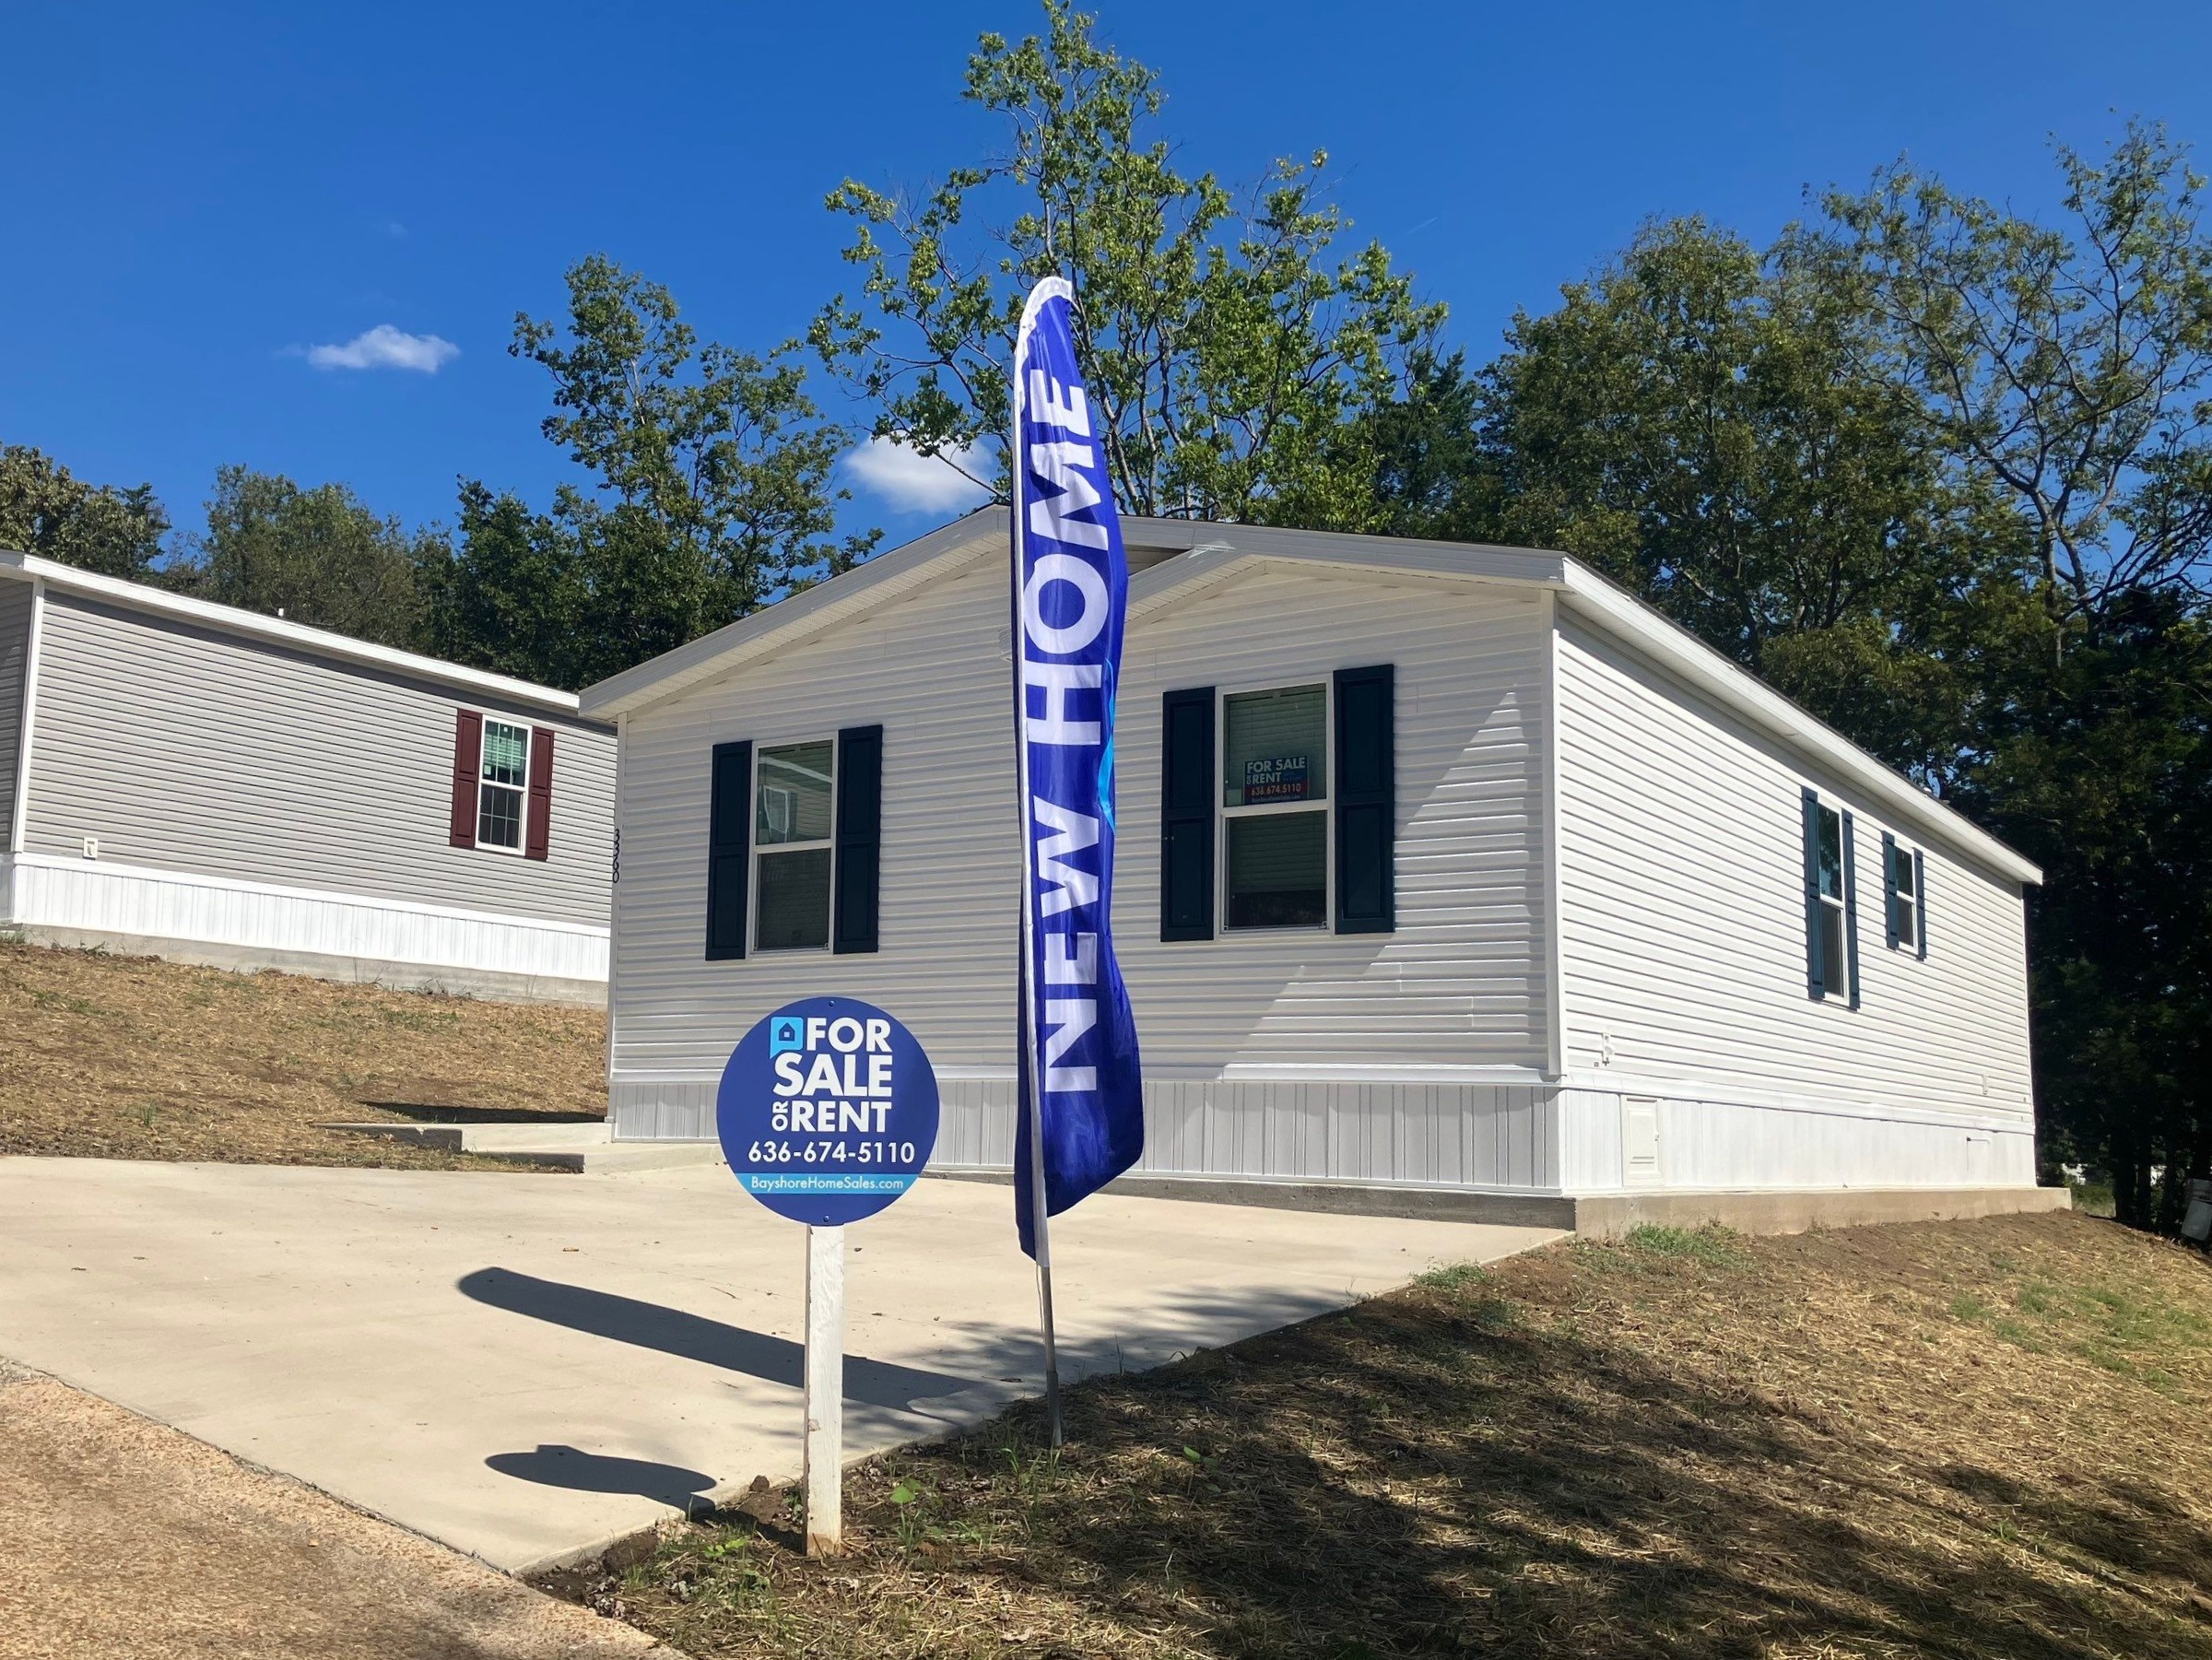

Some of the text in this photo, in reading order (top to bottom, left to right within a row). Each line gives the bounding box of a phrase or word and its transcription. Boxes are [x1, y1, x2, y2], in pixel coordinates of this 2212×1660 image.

[1024, 369, 1109, 1093] NEW HOME
[1247, 757, 1305, 774] FOR SALE
[1251, 783, 1301, 795] 636.674.5110
[1253, 772, 1282, 784] RENT
[806, 1017, 892, 1053] FOR
[772, 1053, 893, 1097] SALE
[771, 1100, 892, 1133] OR RENT
[747, 1141, 915, 1163] 636-674-5110
[750, 1175, 904, 1192] BayshoreHomeSales.com
